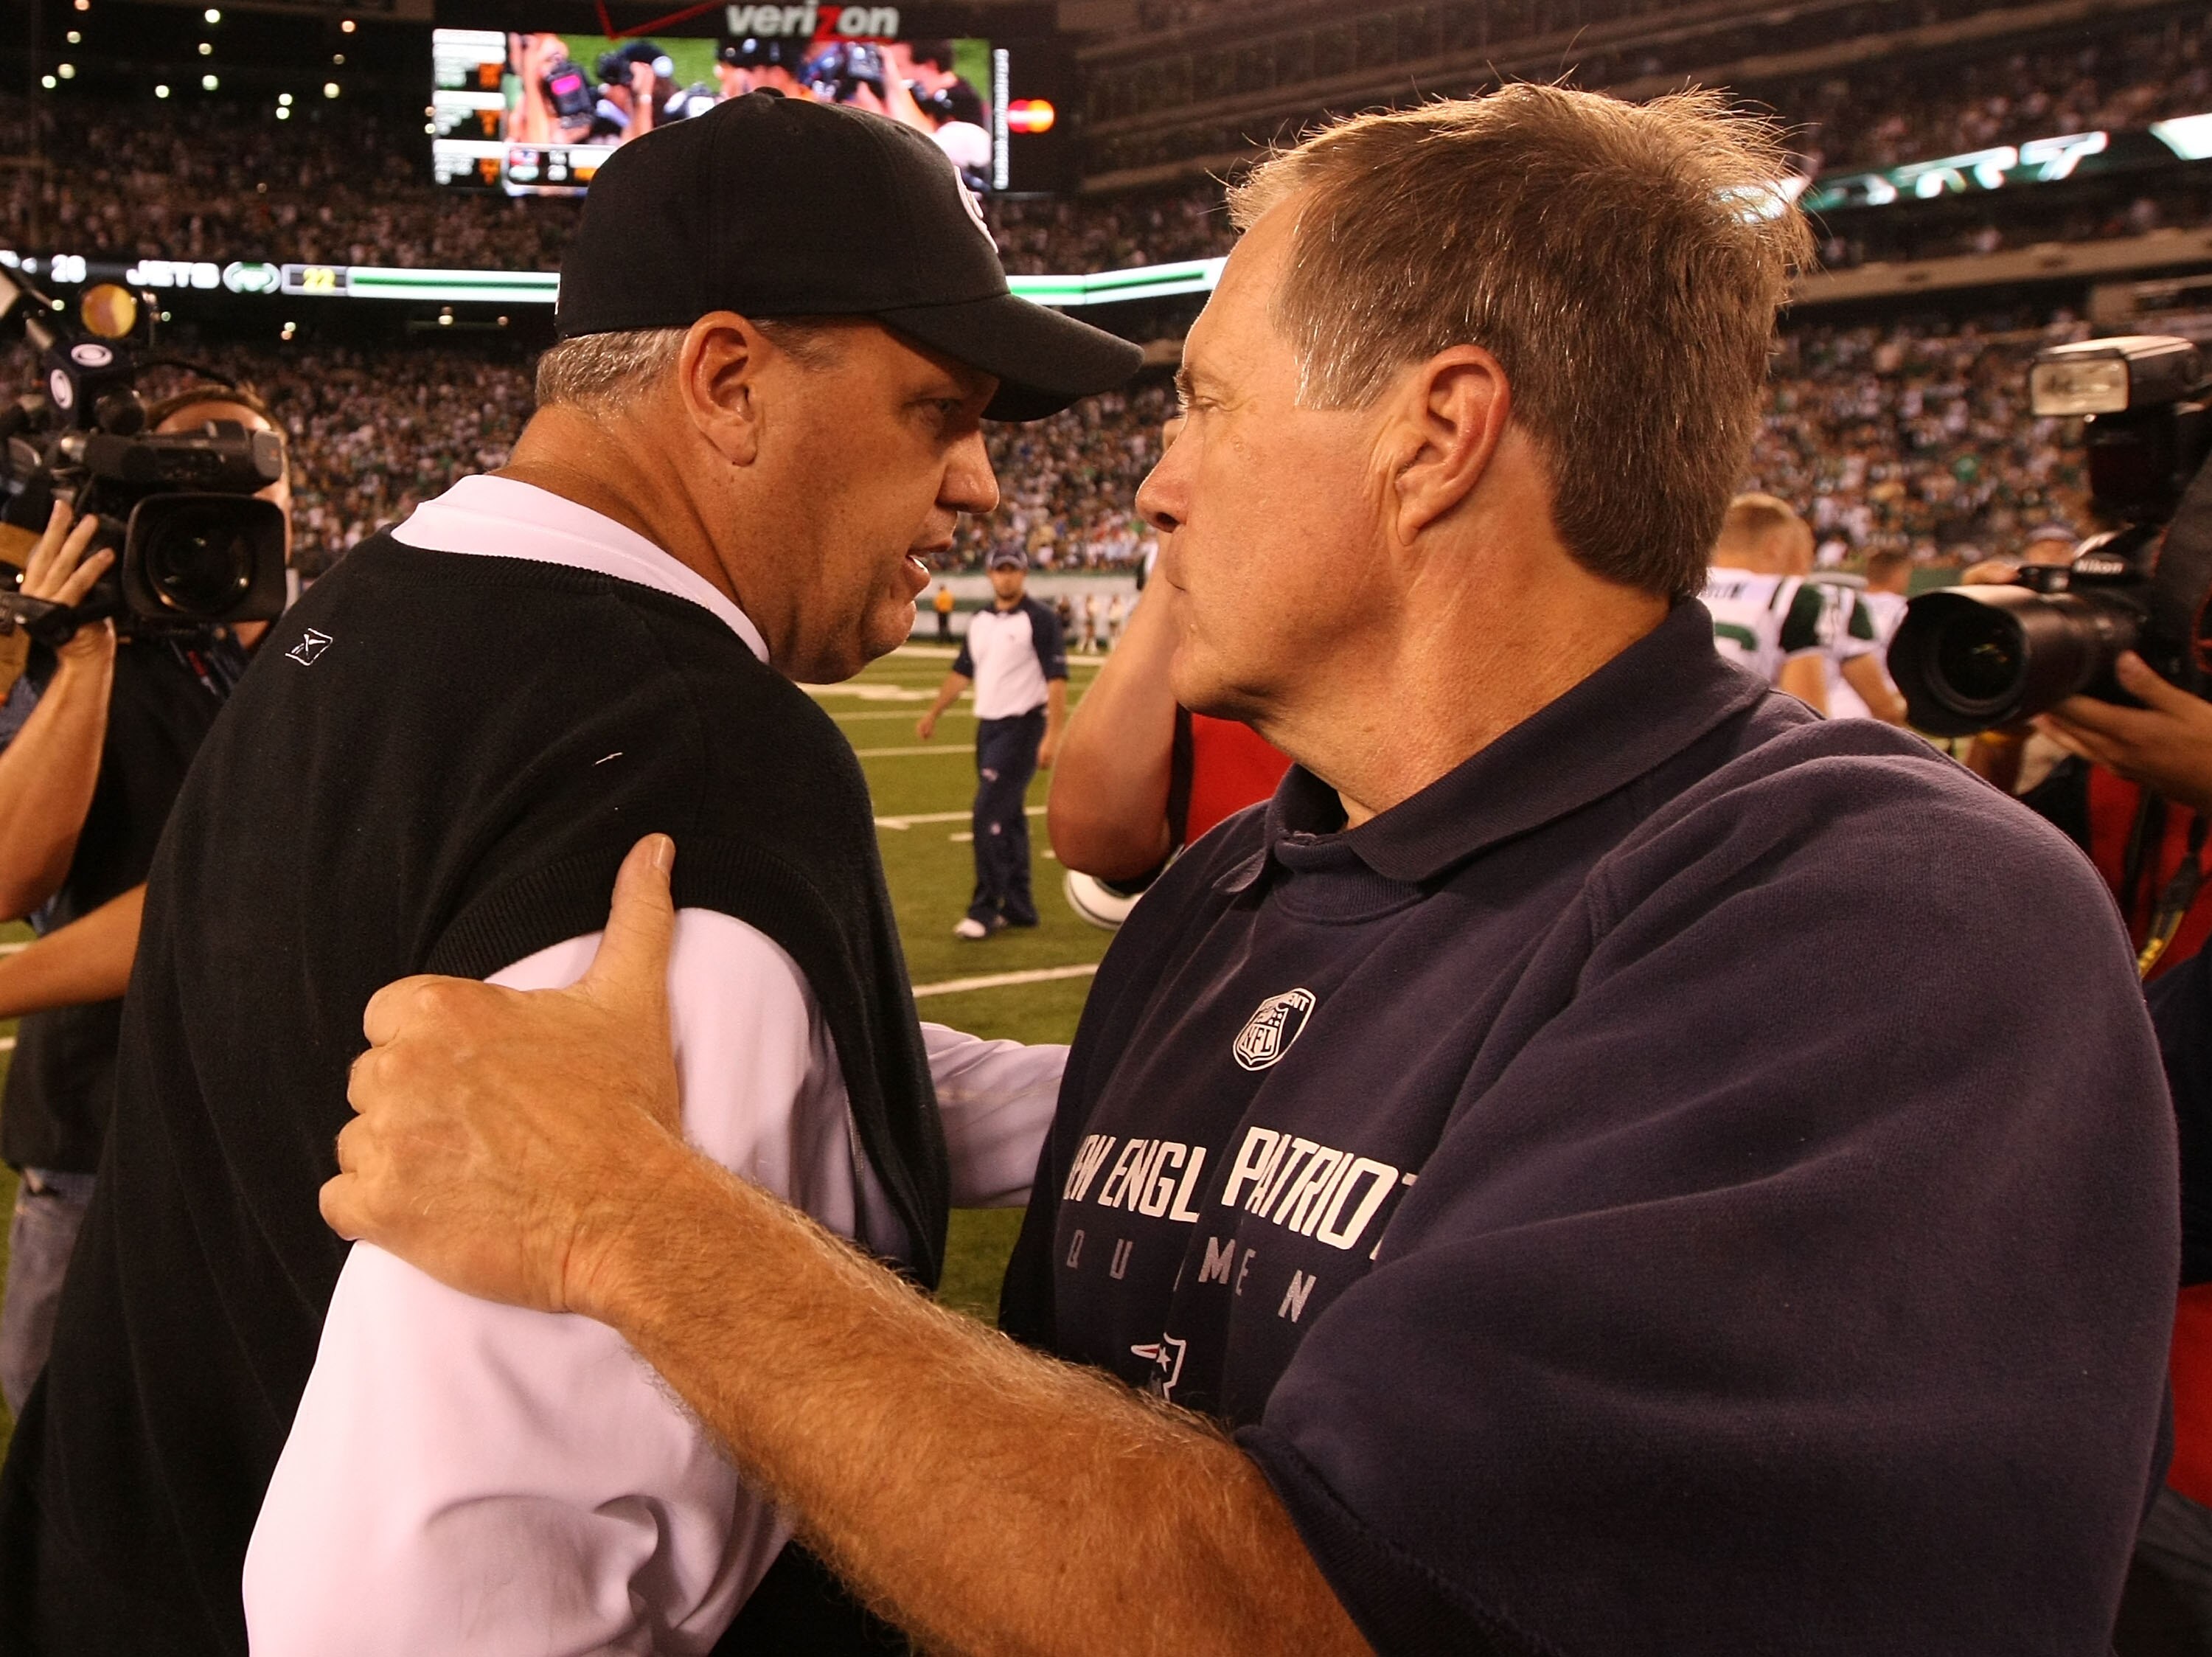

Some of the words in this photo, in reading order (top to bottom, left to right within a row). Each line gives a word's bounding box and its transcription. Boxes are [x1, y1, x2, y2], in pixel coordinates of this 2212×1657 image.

[726, 0, 900, 41] verizon
[2072, 558, 2124, 574] Nikon
[1241, 1025, 1274, 1054] NFL
[1062, 1134, 1117, 1202] EW
